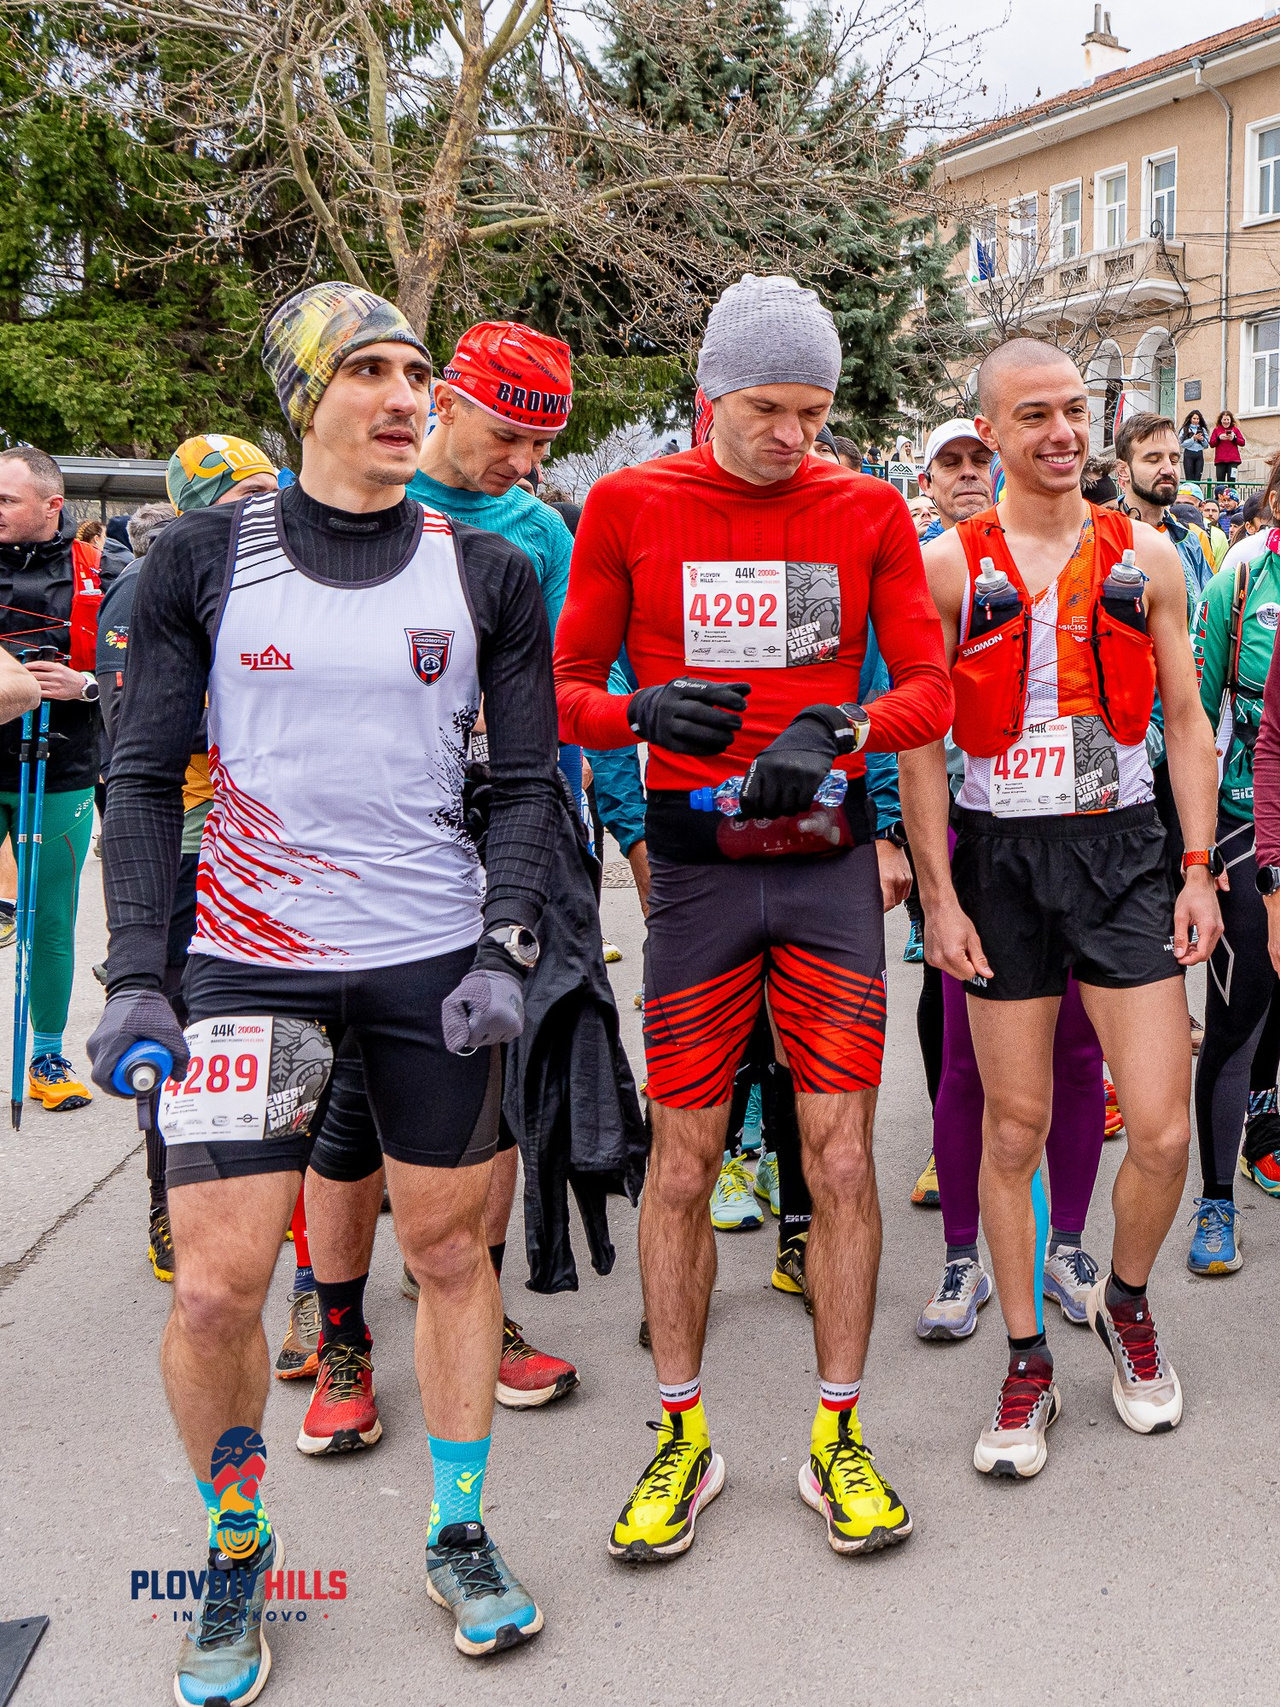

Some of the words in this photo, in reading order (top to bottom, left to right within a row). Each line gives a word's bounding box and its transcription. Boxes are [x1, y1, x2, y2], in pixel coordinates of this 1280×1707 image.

[735, 567, 756, 579] 44K
[757, 569, 780, 577] 20000+
[689, 593, 778, 627] 4292
[787, 632, 816, 650] STEP
[962, 633, 1003, 658] SALOMON
[1028, 723, 1047, 734] 44K
[993, 746, 1066, 780] 4277
[1076, 781, 1099, 797] STEP
[211, 1024, 235, 1036] 44K
[267, 1100, 298, 1119] STEP
